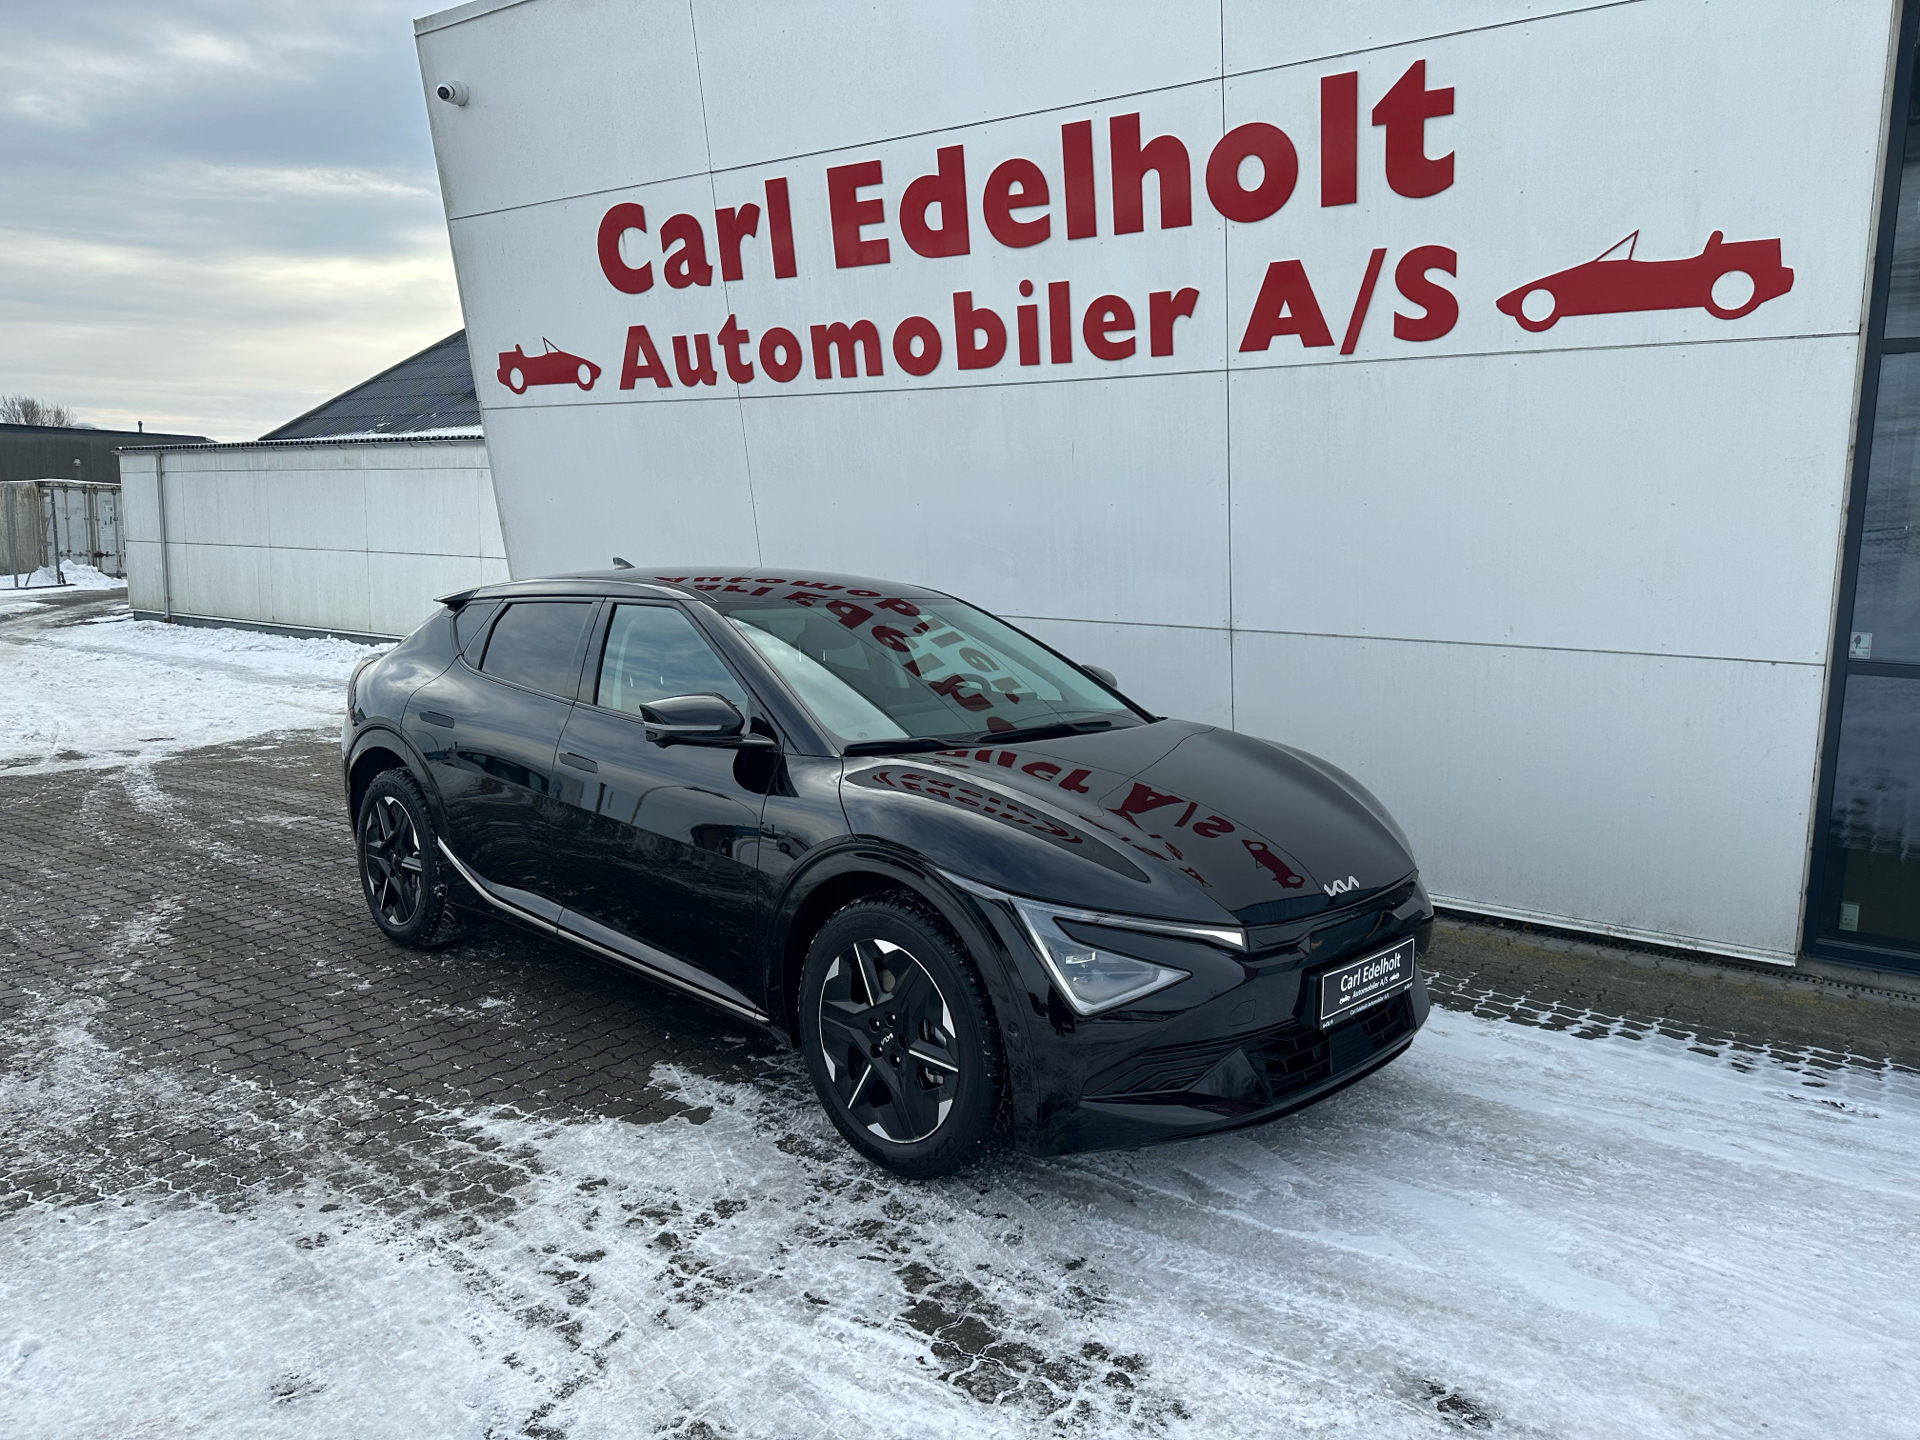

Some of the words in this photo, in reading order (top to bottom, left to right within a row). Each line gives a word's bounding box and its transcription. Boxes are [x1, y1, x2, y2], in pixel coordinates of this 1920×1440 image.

[597, 176, 797, 294] Carl
[826, 59, 1454, 269] Edelholt
[619, 279, 1200, 390] Automobiler
[1239, 244, 1459, 355] A/S
[1340, 968, 1361, 992] Carl
[1363, 952, 1402, 983] Edelholt
[1352, 980, 1380, 999] Automobiler
